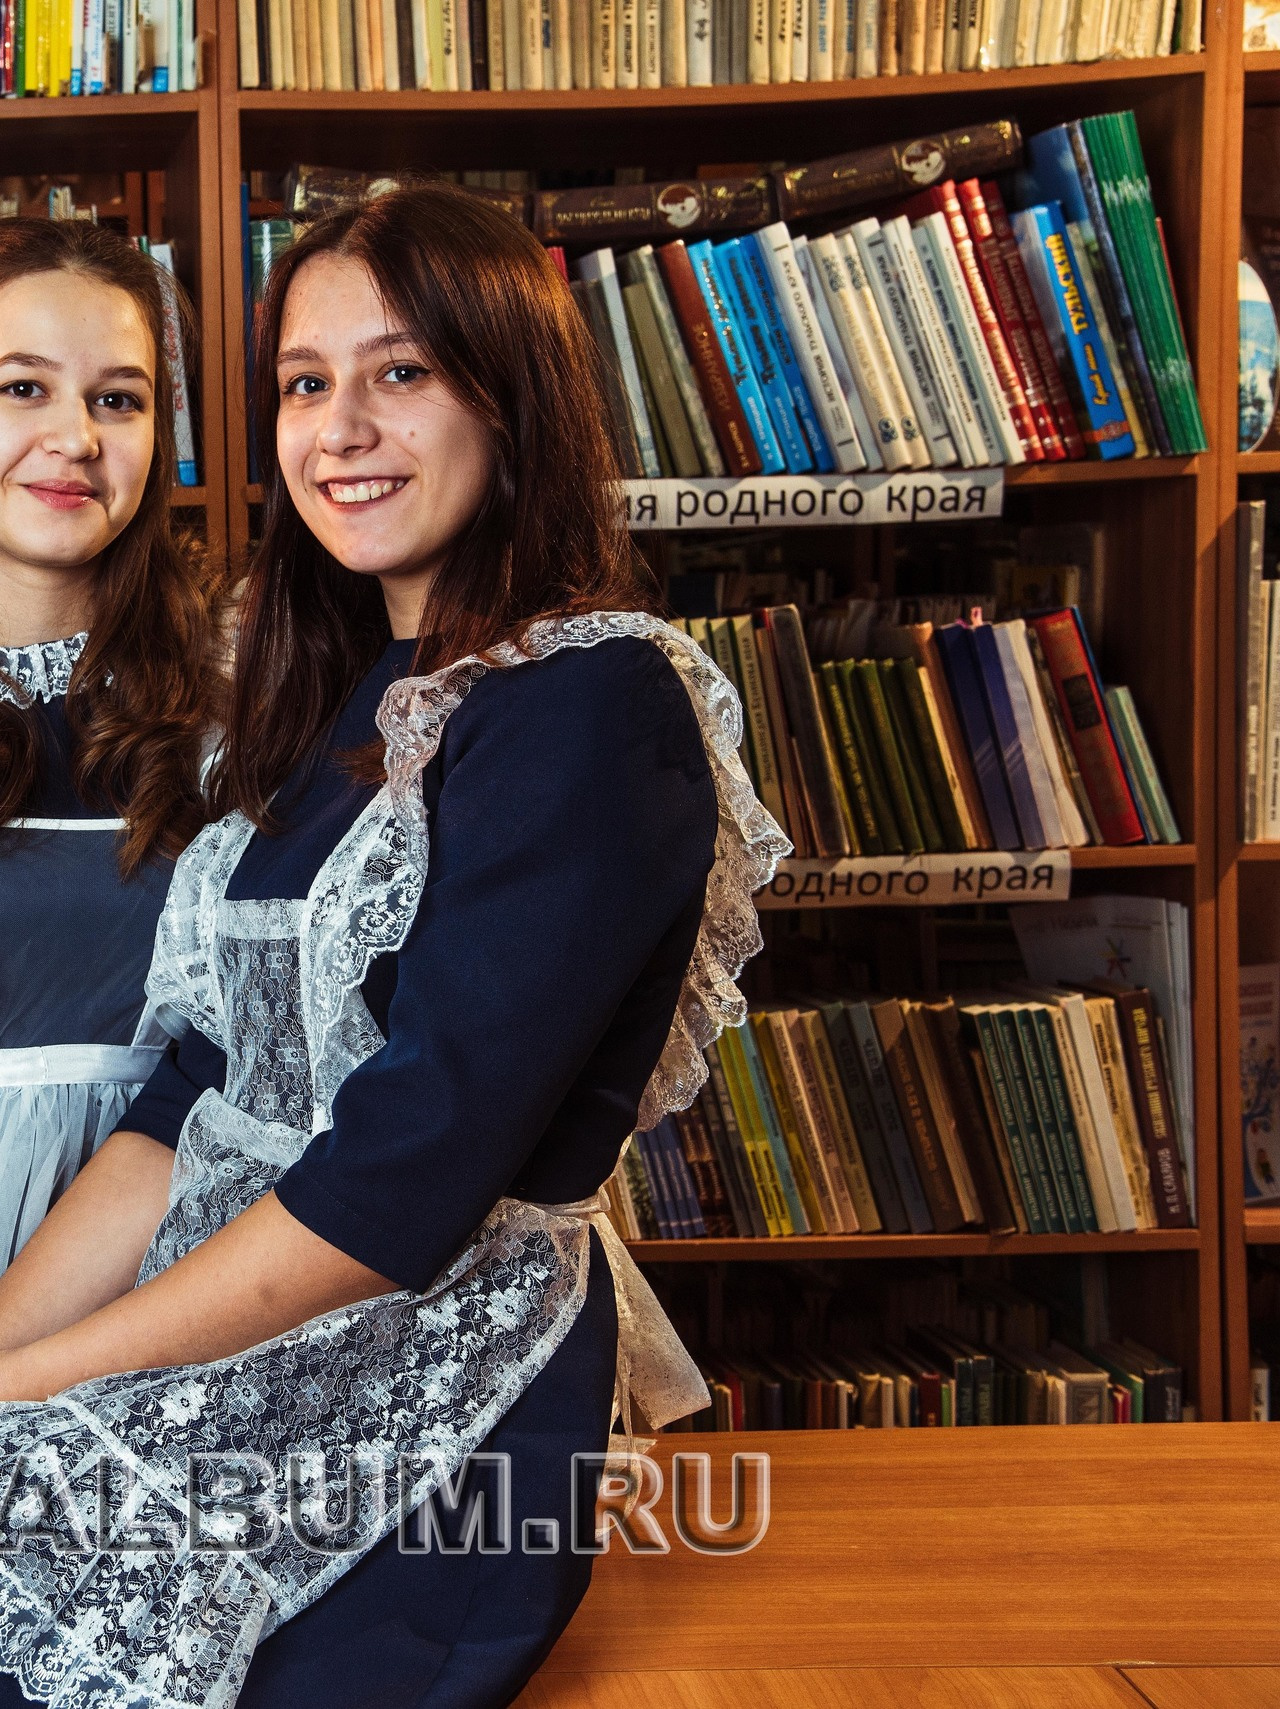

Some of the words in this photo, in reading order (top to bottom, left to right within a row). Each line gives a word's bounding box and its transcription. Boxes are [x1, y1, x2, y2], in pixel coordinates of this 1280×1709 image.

[781, 259, 799, 289] КРАЯ
[875, 254, 892, 285] КРАЯ
[1043, 230, 1090, 336] ТУЛЬСКИЙ
[792, 291, 819, 351] ТУЛЬСКОГО
[885, 286, 913, 347] ТУЛЬСКОГО
[812, 353, 836, 404] ИСТОРИЯ
[906, 348, 931, 399] ИСТОРИЯ
[675, 487, 864, 527] родного
[886, 484, 987, 522] края
[952, 863, 1054, 898] края
[1156, 1147, 1177, 1193] САХАРОВ
